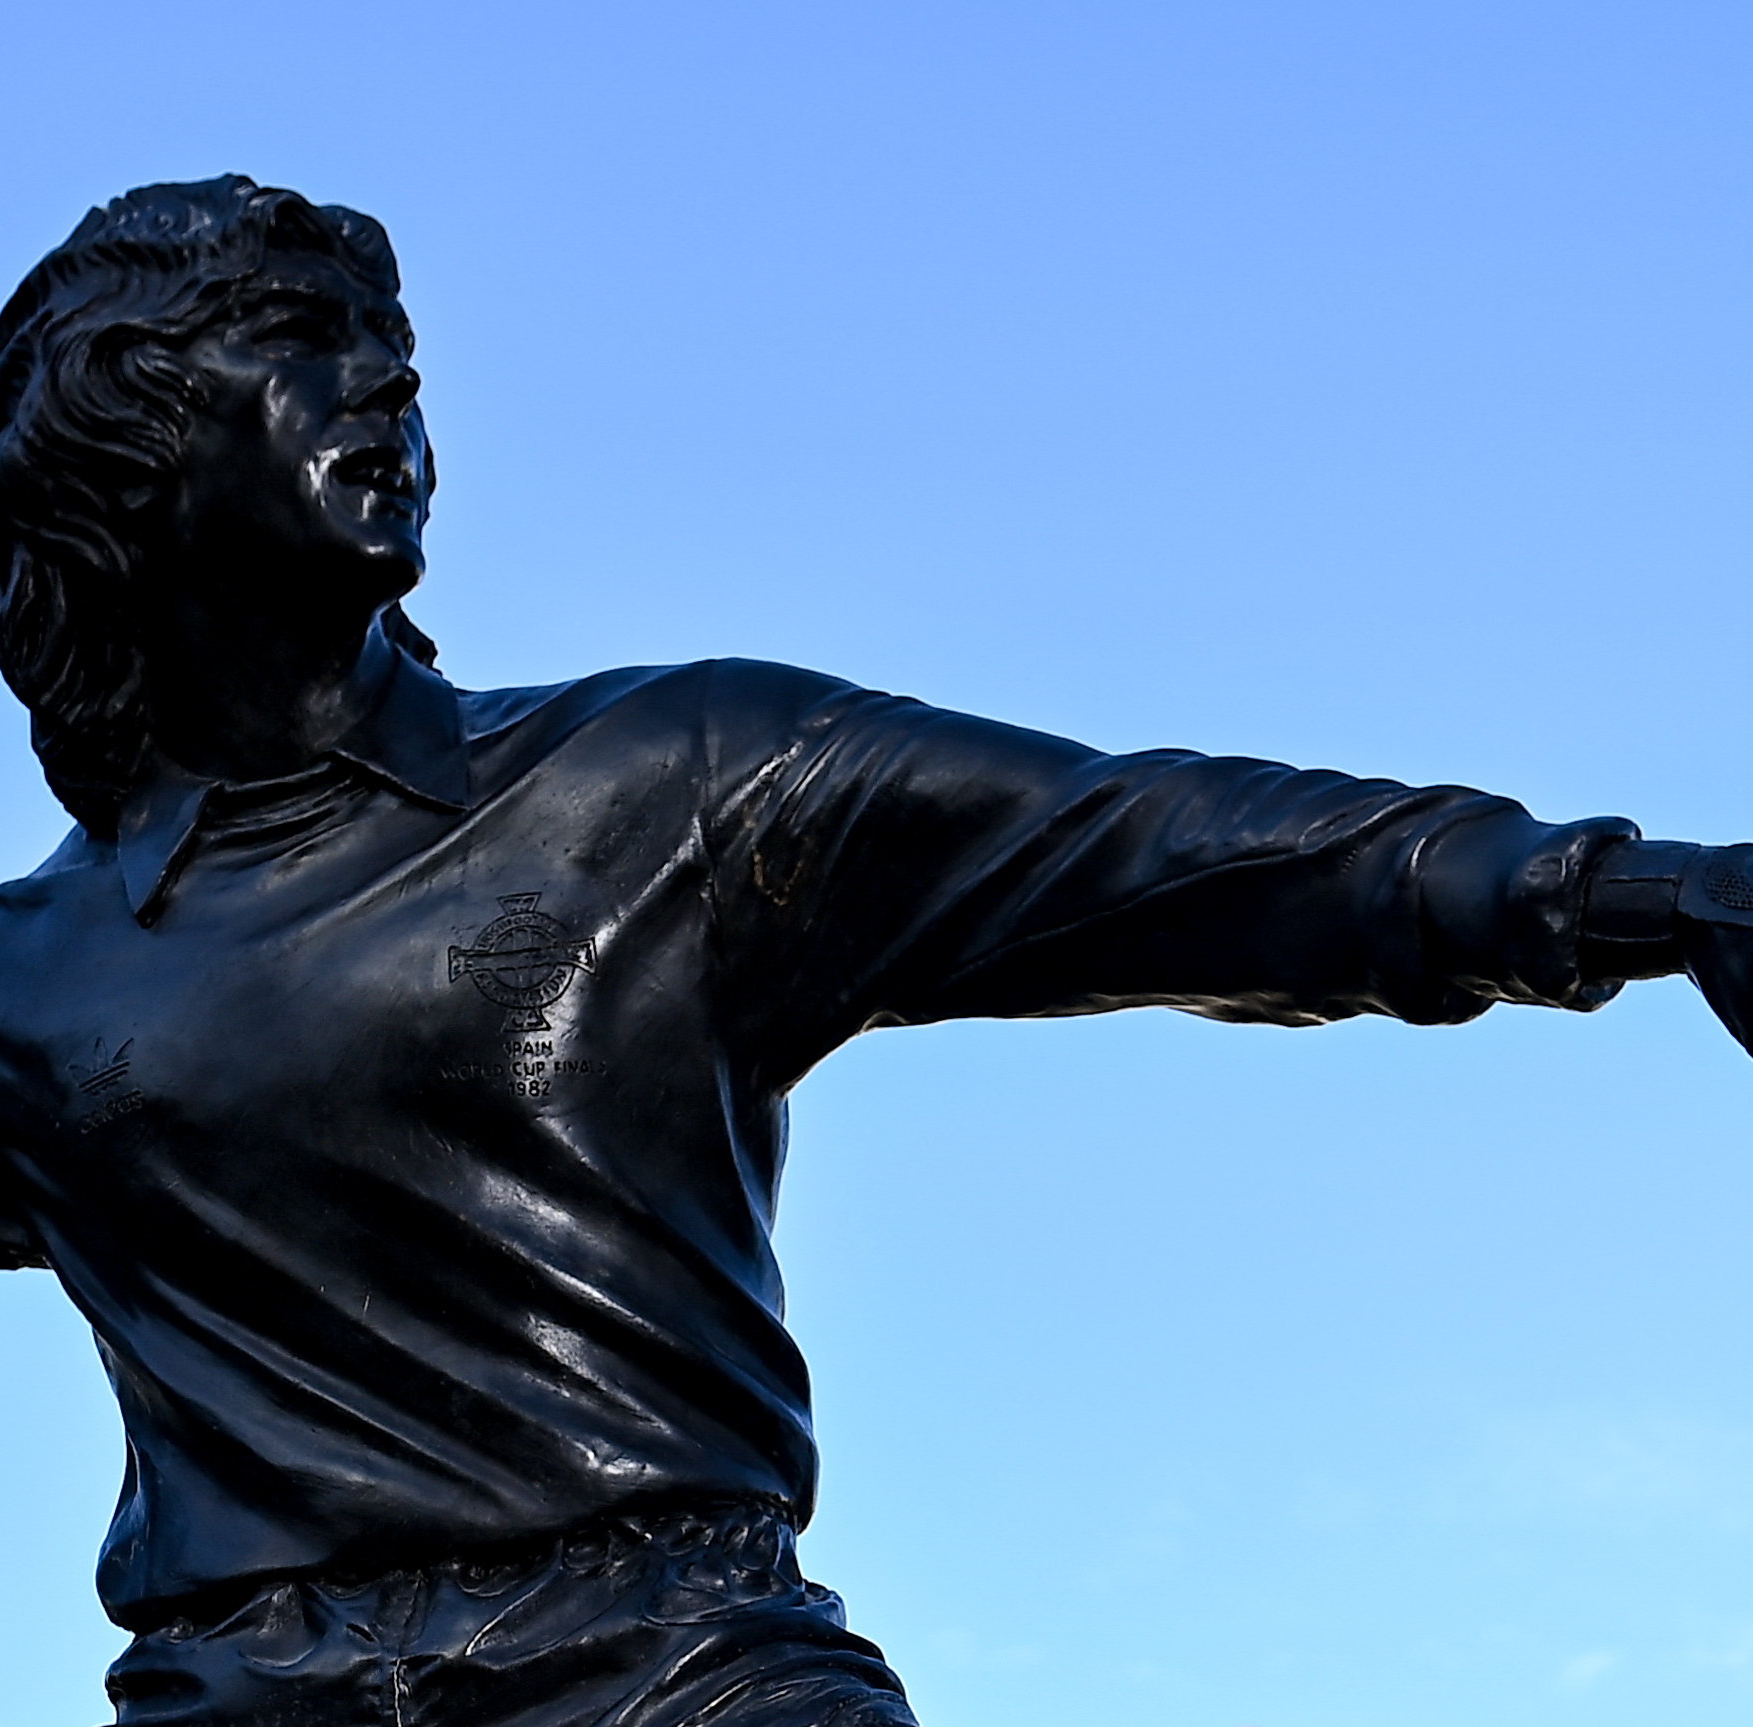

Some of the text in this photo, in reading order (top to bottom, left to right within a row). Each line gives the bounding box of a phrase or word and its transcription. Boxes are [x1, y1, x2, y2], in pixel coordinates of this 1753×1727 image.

[502, 1040, 553, 1059] SPAIN
[510, 1061, 545, 1078] CUP
[507, 1080, 551, 1098] 1982
